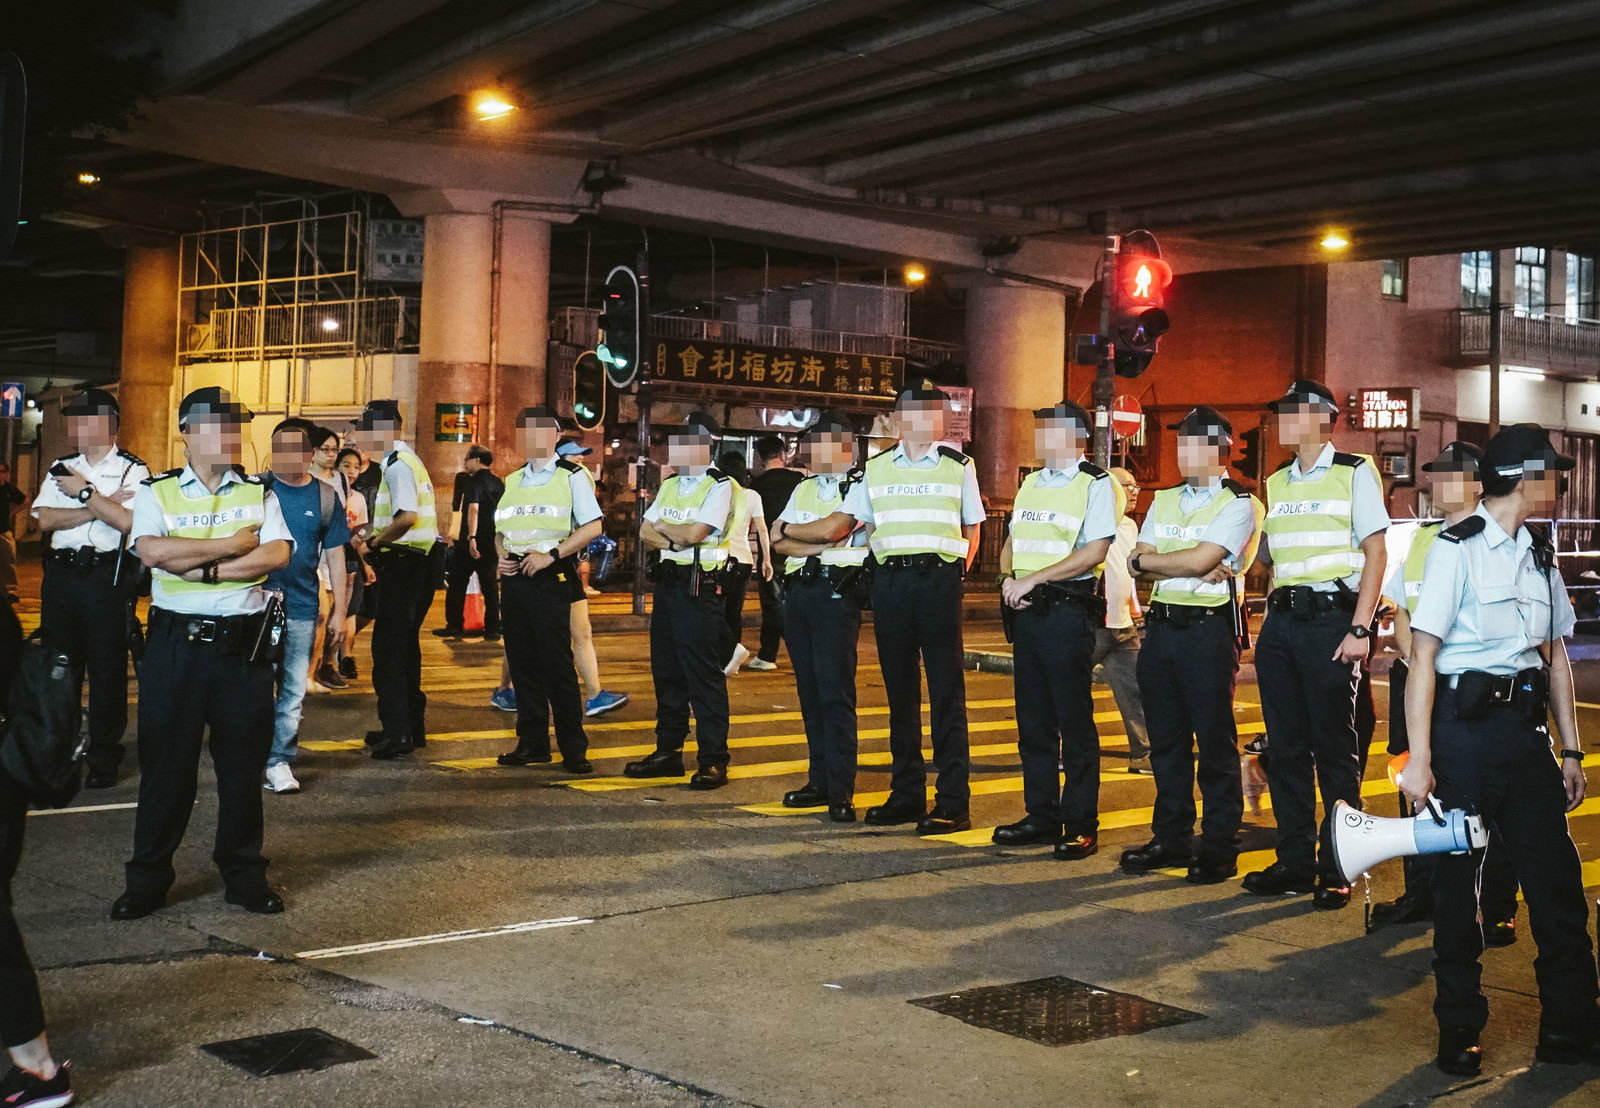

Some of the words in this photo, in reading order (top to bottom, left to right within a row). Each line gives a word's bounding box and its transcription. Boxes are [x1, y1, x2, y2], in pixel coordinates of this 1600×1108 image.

[1363, 391, 1388, 401] FIRE
[1363, 400, 1407, 410] STATION
[1363, 410, 1407, 428] 消防局
[897, 485, 930, 494] POLICE
